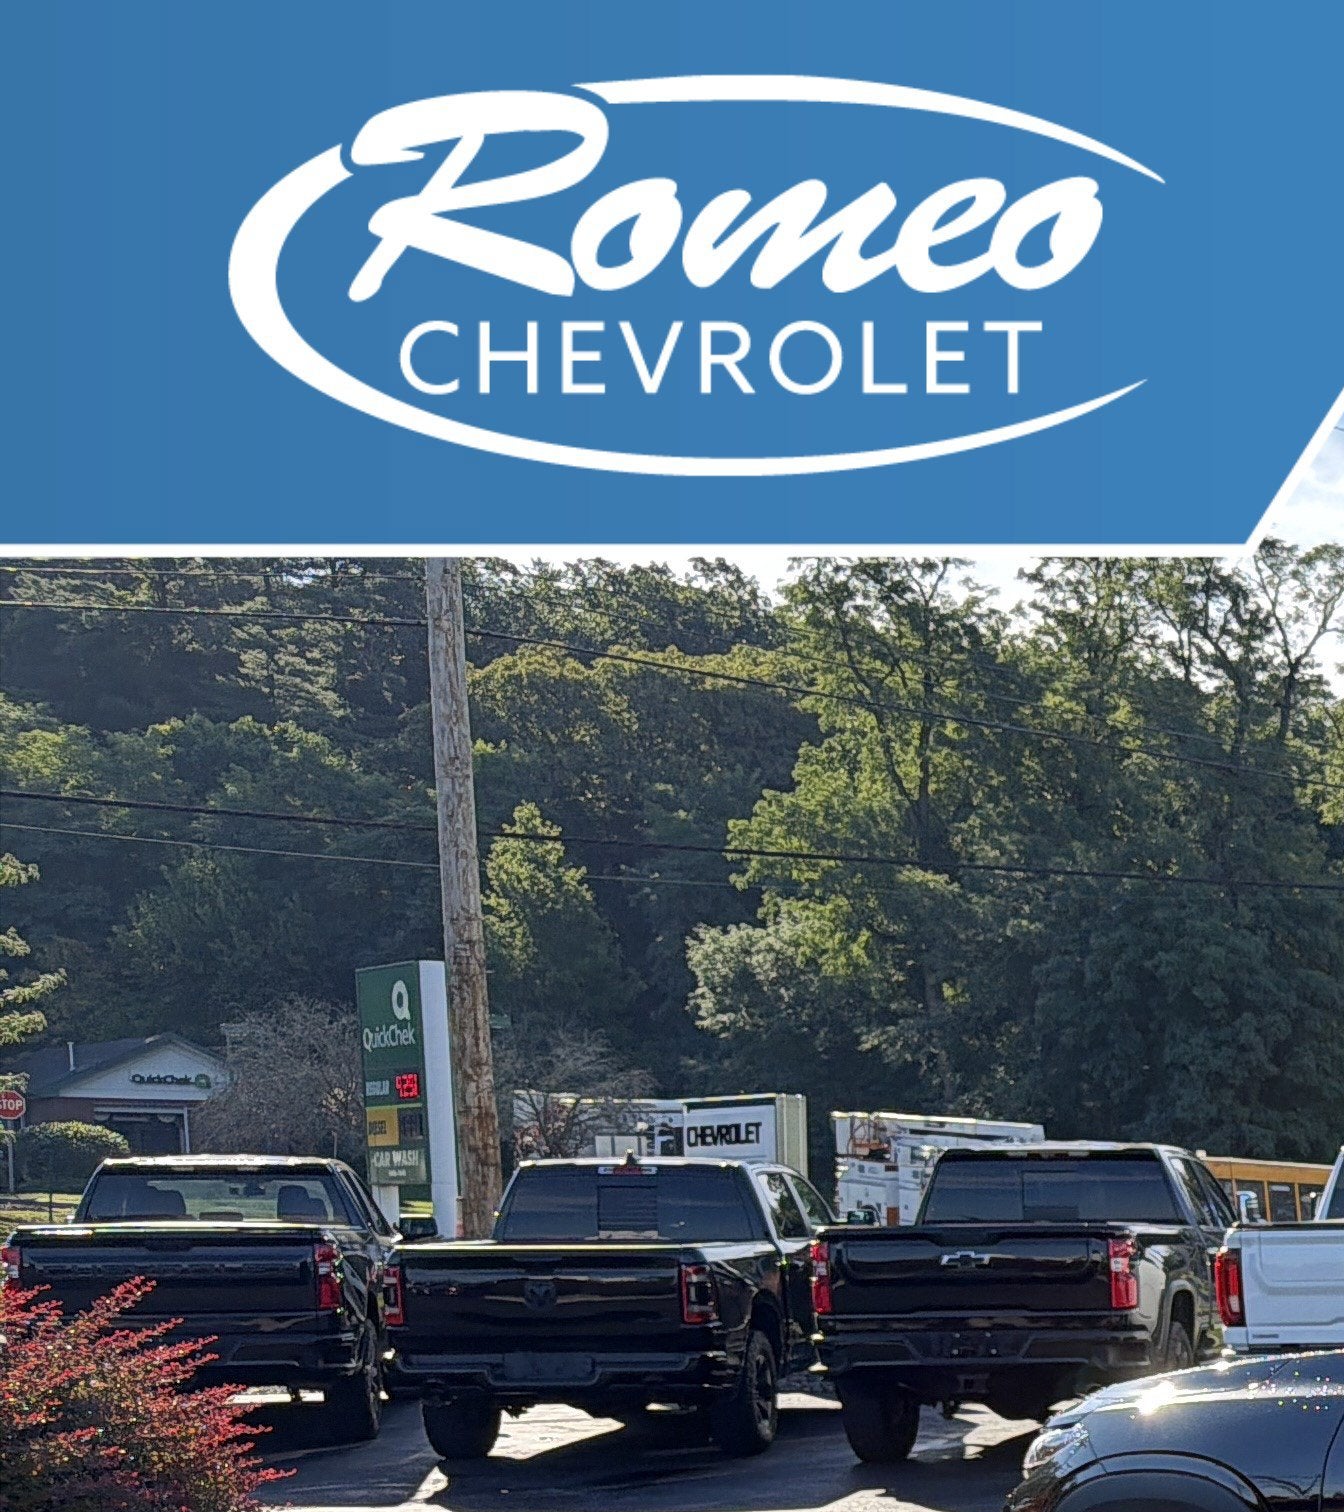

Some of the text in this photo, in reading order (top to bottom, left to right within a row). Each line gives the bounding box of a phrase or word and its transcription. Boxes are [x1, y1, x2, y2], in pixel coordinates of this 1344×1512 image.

[363, 1022, 415, 1052] QuickChek
[687, 1122, 762, 1147] CHEVROLET
[374, 1150, 419, 1167] CAR WASH
